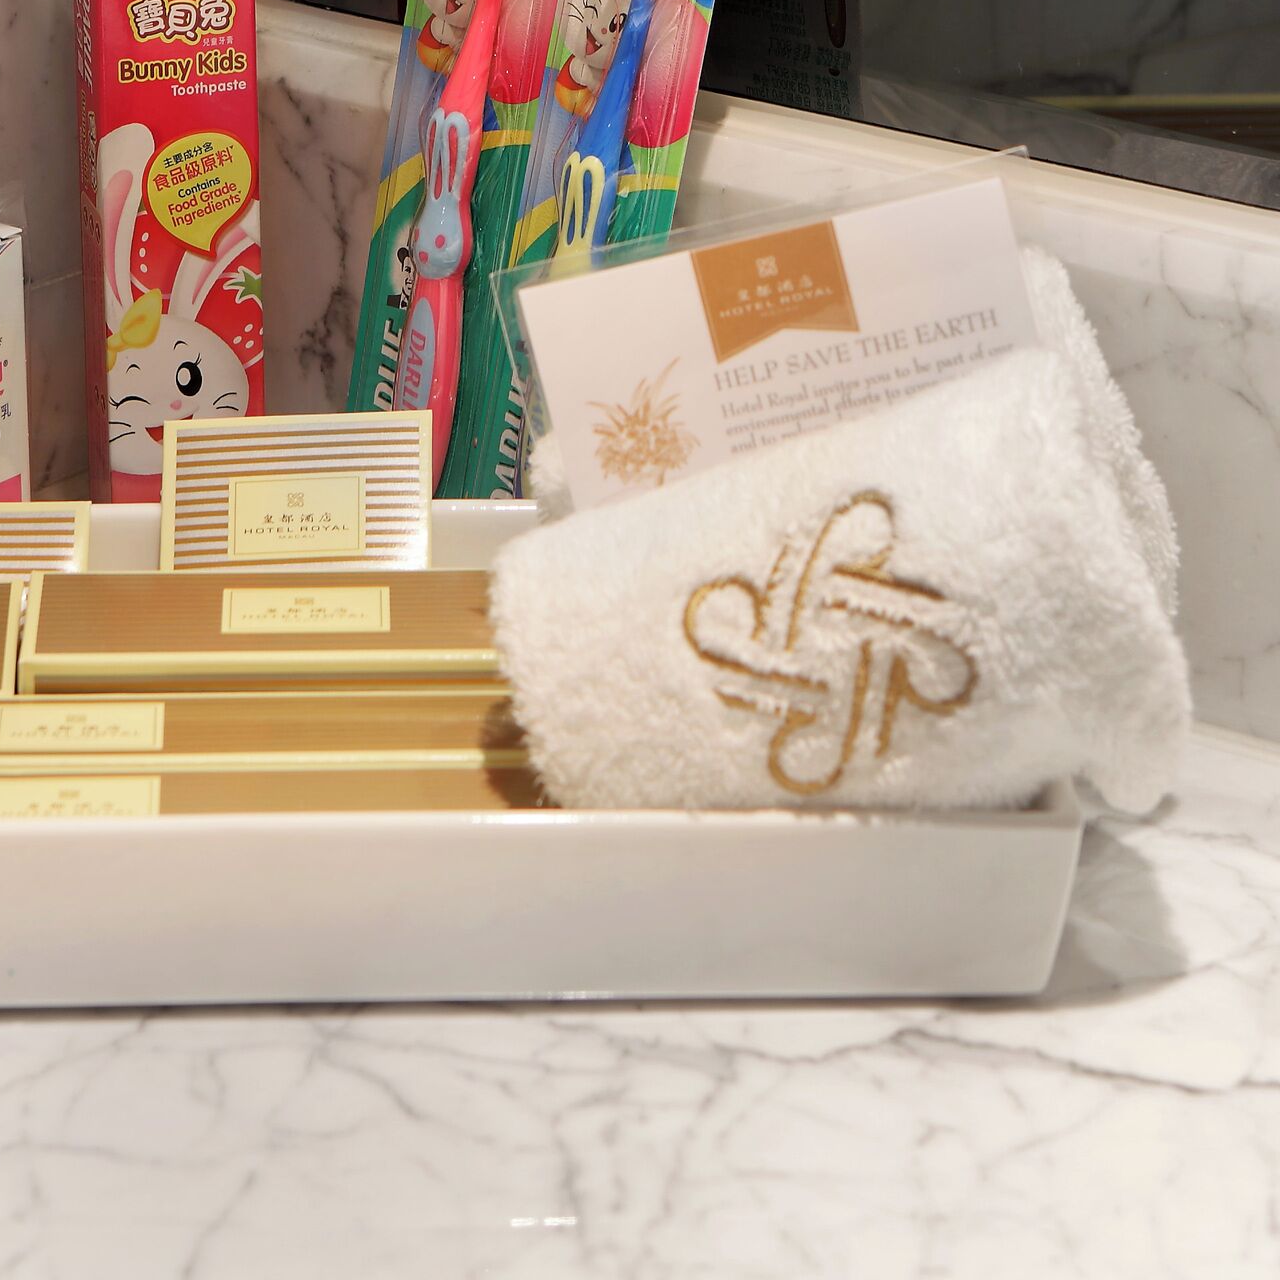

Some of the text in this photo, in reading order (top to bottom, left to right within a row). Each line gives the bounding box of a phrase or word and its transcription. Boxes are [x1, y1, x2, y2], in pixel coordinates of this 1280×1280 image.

[203, 35, 233, 46] 兒童牙膏
[120, 49, 246, 82] Bunny Kids
[171, 80, 247, 96] Toothpaste
[153, 148, 232, 191] 食品級原料
[163, 142, 214, 168] 主要成分含
[168, 182, 237, 215] Food Grade
[178, 177, 220, 198] Contains
[720, 287, 833, 318] HOTEL ROYAL
[713, 308, 999, 392] HELP SAVE THE EARTH
[721, 394, 764, 418] Hotel
[767, 385, 810, 410] Royal
[814, 377, 861, 398] invites
[865, 374, 890, 389] you
[895, 365, 911, 378] to
[915, 359, 930, 373] be
[935, 354, 965, 374] part
[970, 341, 986, 361] of
[726, 404, 830, 435] environmental
[835, 390, 880, 418] efforts
[730, 433, 757, 453] and
[761, 431, 776, 445] to
[244, 526, 293, 534] HOTEL
